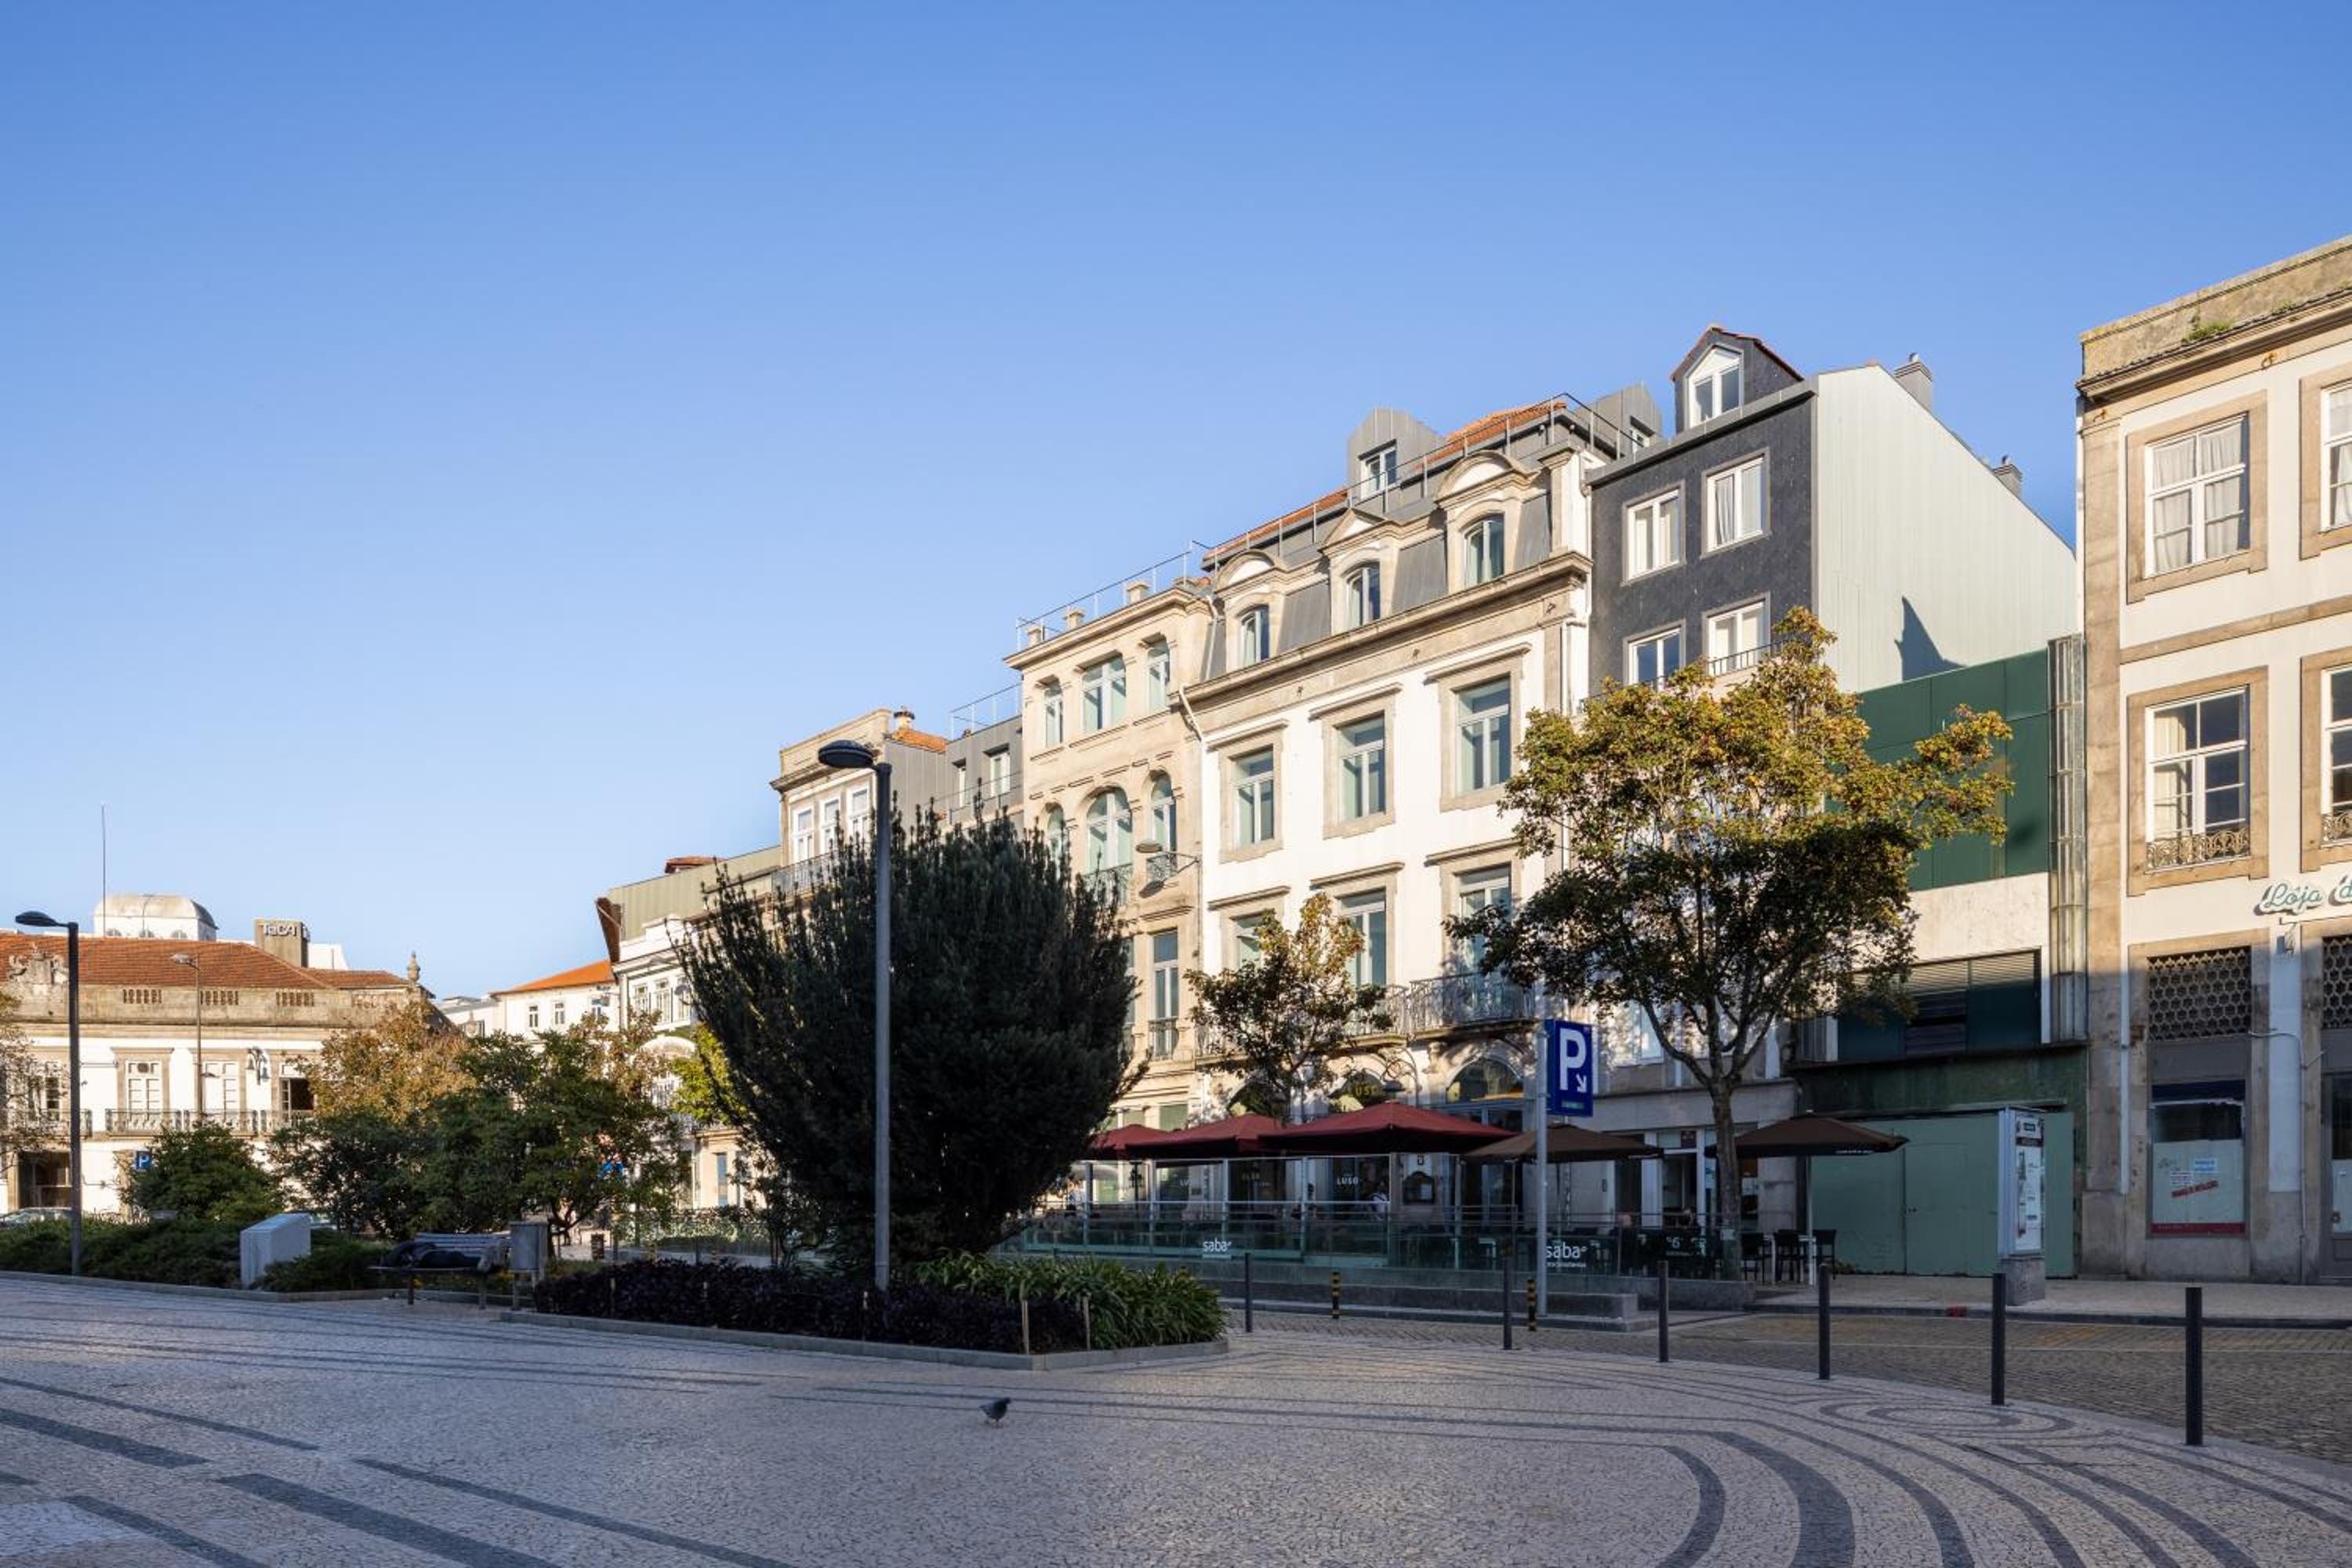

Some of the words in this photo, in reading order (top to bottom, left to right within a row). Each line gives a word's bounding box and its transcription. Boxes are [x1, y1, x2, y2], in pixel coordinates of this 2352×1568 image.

[2263, 882, 2323, 911] Loja
[1559, 1026, 1588, 1092] P
[139, 1153, 150, 1167] P
[1337, 1177, 1359, 1185] LUSO
[1546, 1241, 1581, 1258] saba
